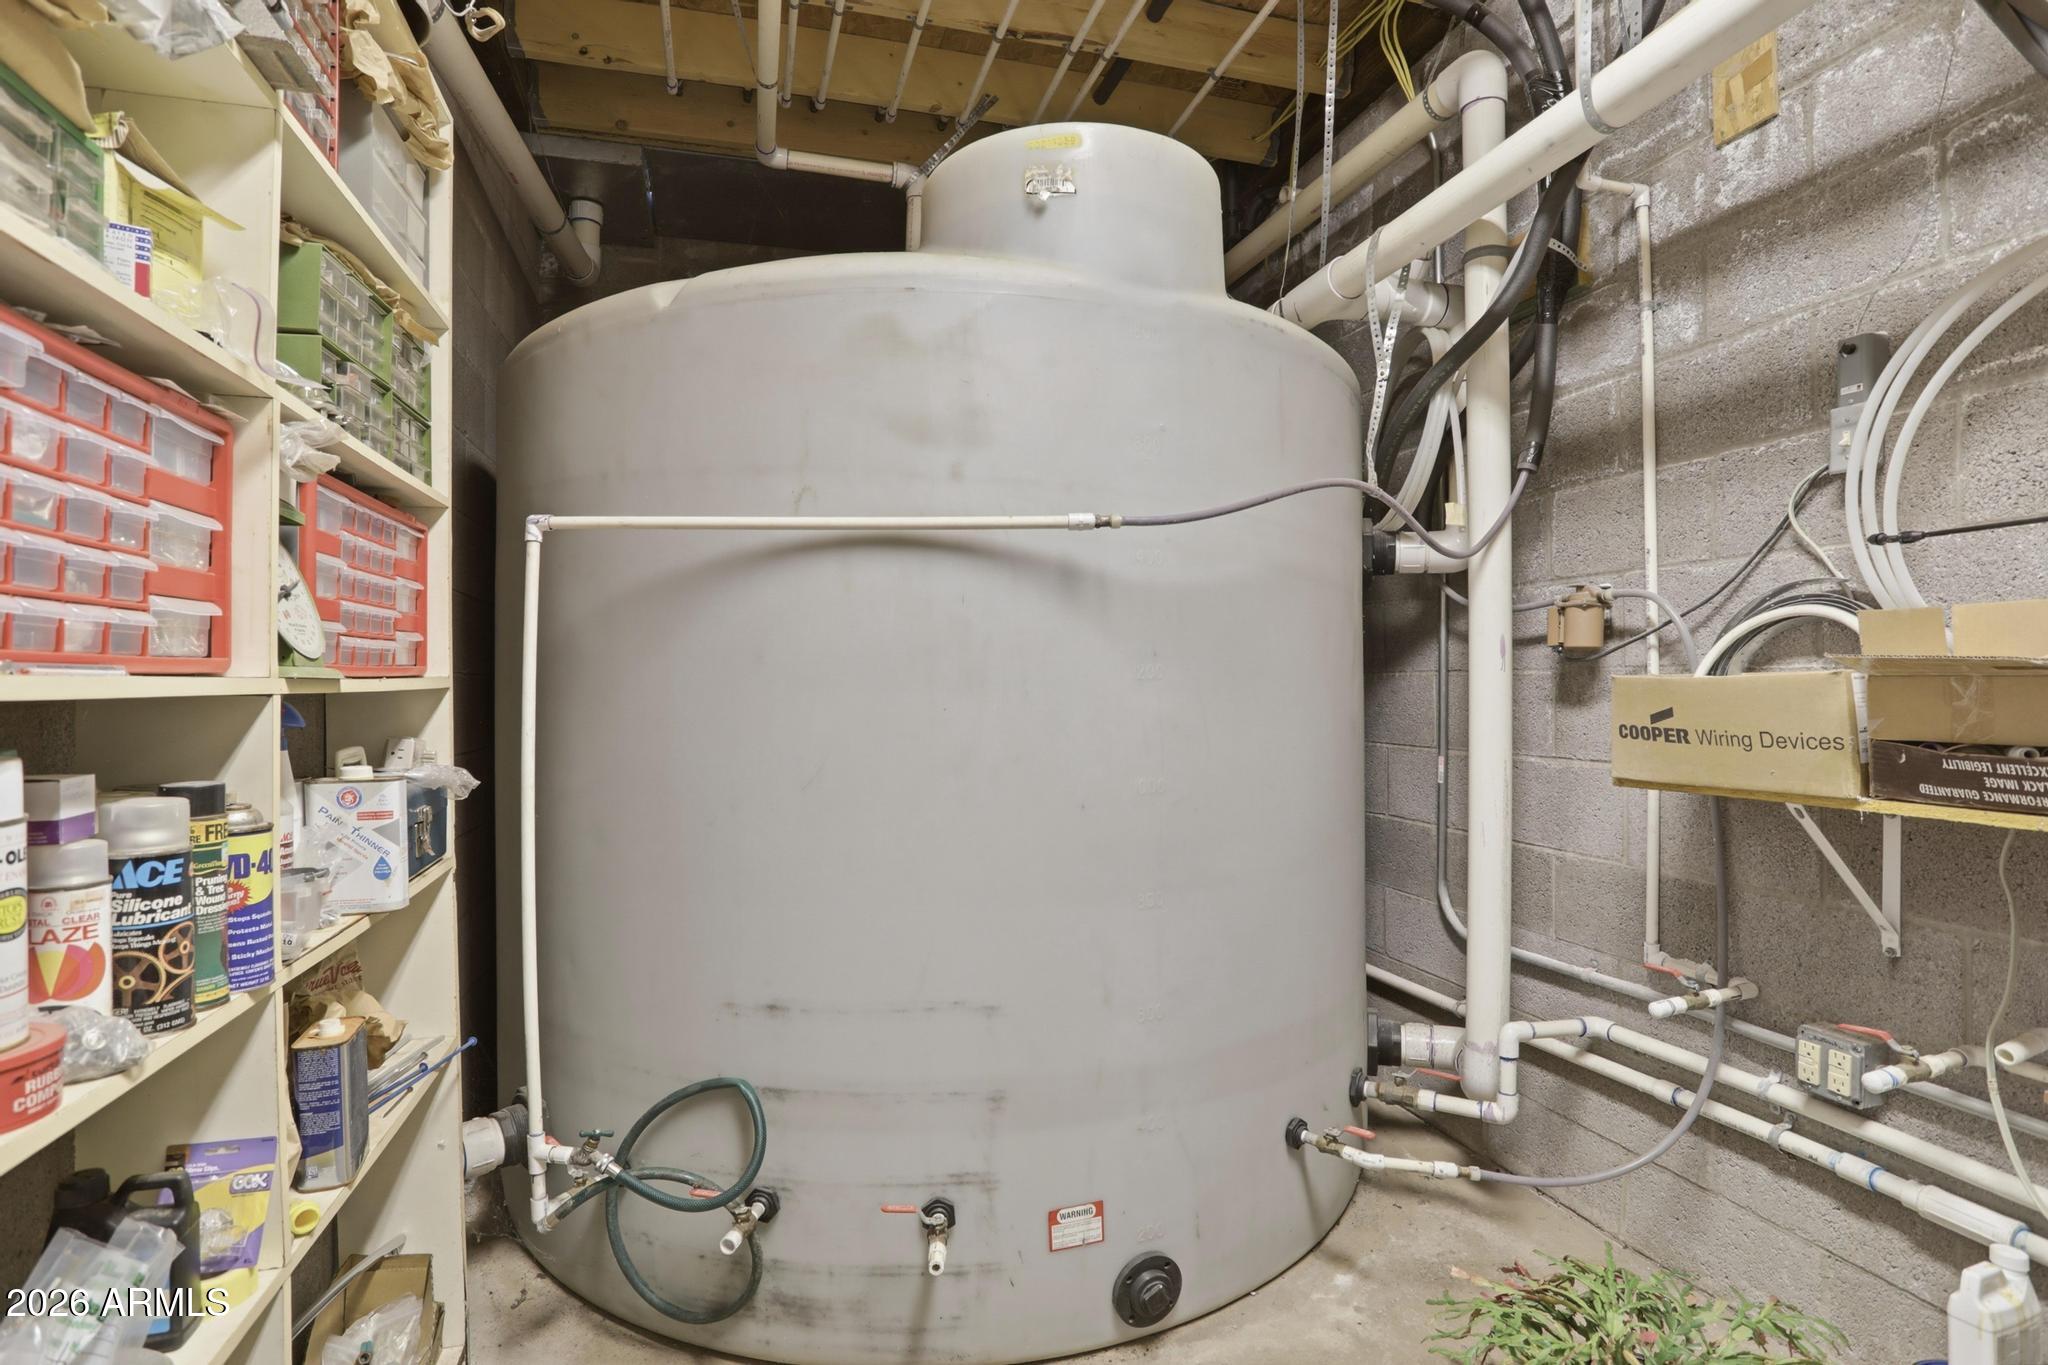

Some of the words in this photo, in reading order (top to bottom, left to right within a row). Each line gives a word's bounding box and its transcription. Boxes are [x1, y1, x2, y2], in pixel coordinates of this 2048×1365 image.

[1619, 723, 1691, 745] COOPER
[1695, 729, 1752, 752] Wiring
[1759, 731, 1845, 751] Devices
[1942, 758, 1993, 773] LEGIBILITY
[1996, 762, 2048, 778] XCELLENT
[1919, 783, 1980, 801] GUARANTEED
[1984, 776, 2019, 791] IMAGE
[2022, 780, 2048, 793] LACK
[1982, 791, 2048, 808] RFORMANCE
[318, 805, 345, 826] PAIN
[351, 825, 391, 857] THINNER
[112, 857, 184, 890] ACE
[195, 885, 204, 896] &
[112, 894, 183, 913] Silicone
[61, 911, 101, 925] CLEAR
[112, 902, 193, 926] Lubricant
[29, 922, 99, 946] LAZE
[1059, 1206, 1094, 1221] WARNING
